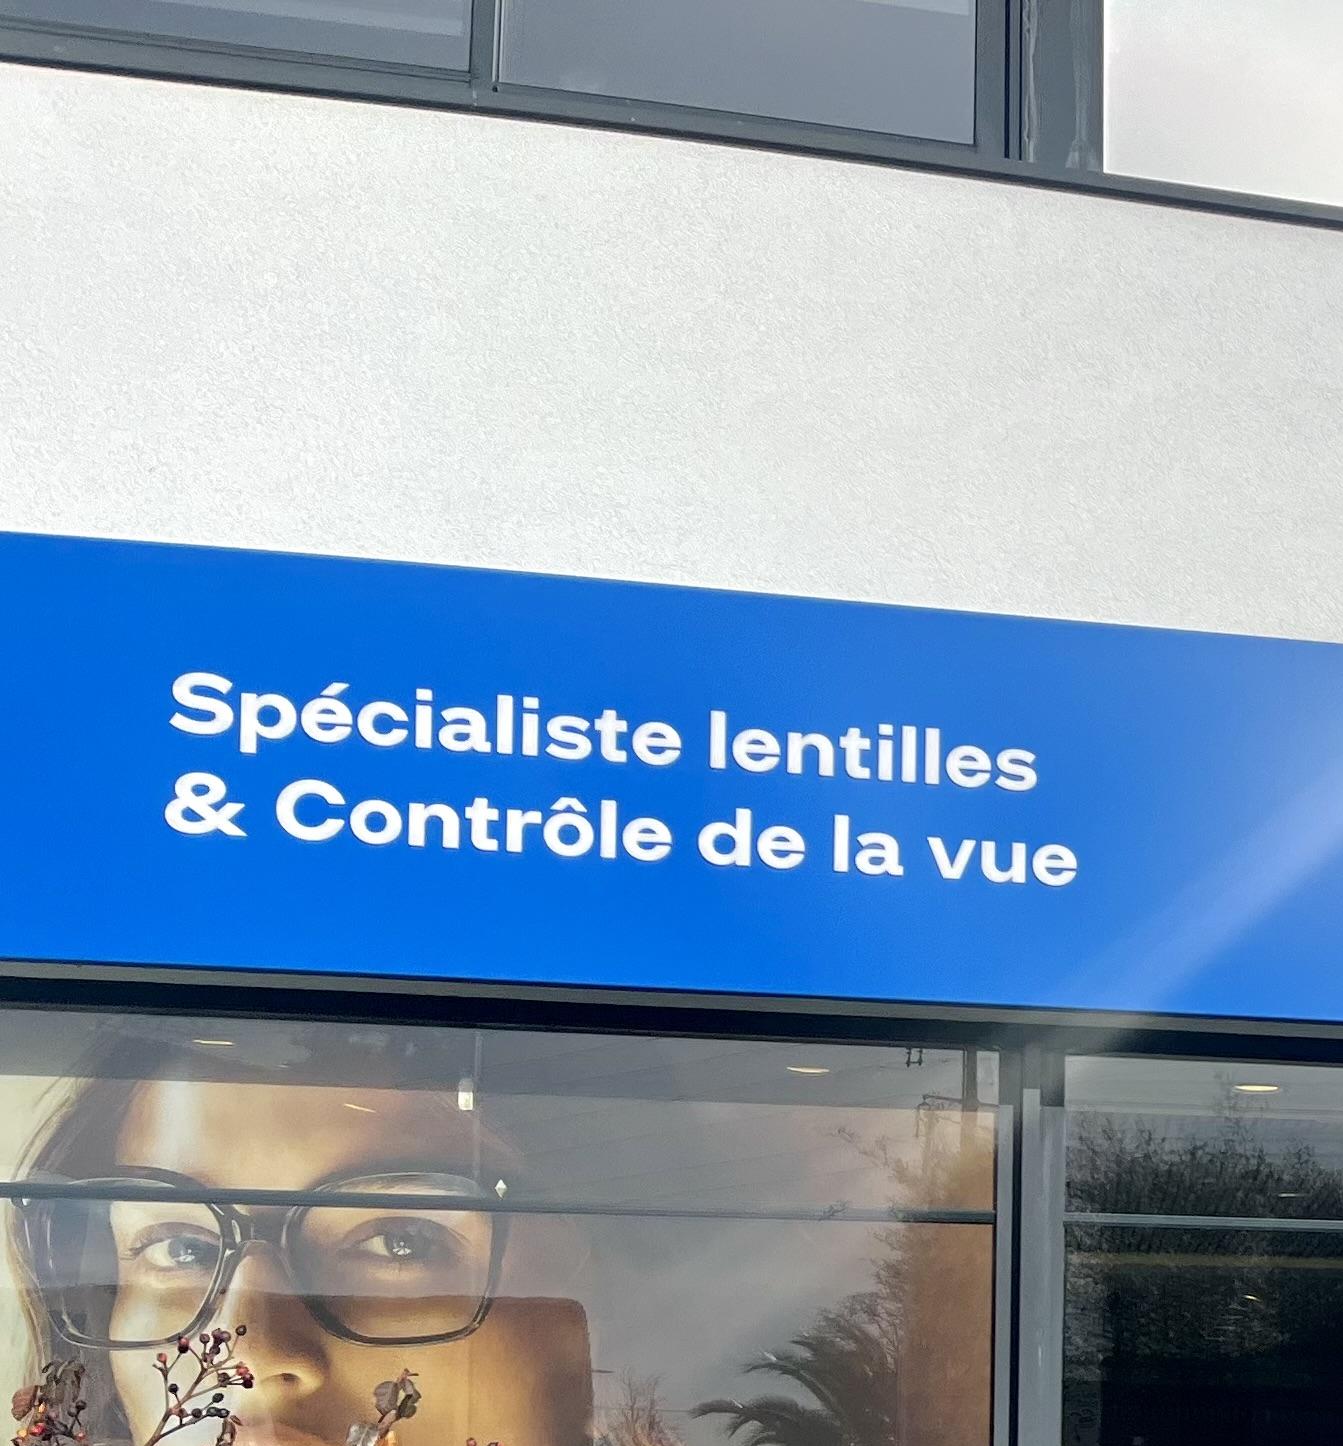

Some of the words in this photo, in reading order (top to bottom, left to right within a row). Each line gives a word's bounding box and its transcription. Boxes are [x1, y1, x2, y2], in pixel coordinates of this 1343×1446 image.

[169, 671, 682, 767] Spécialiste
[709, 710, 1038, 792] lentilles
[164, 771, 248, 837] &
[276, 778, 673, 863] Contrôle
[698, 807, 806, 871] de
[833, 814, 904, 876] la
[927, 835, 1078, 888] vue
